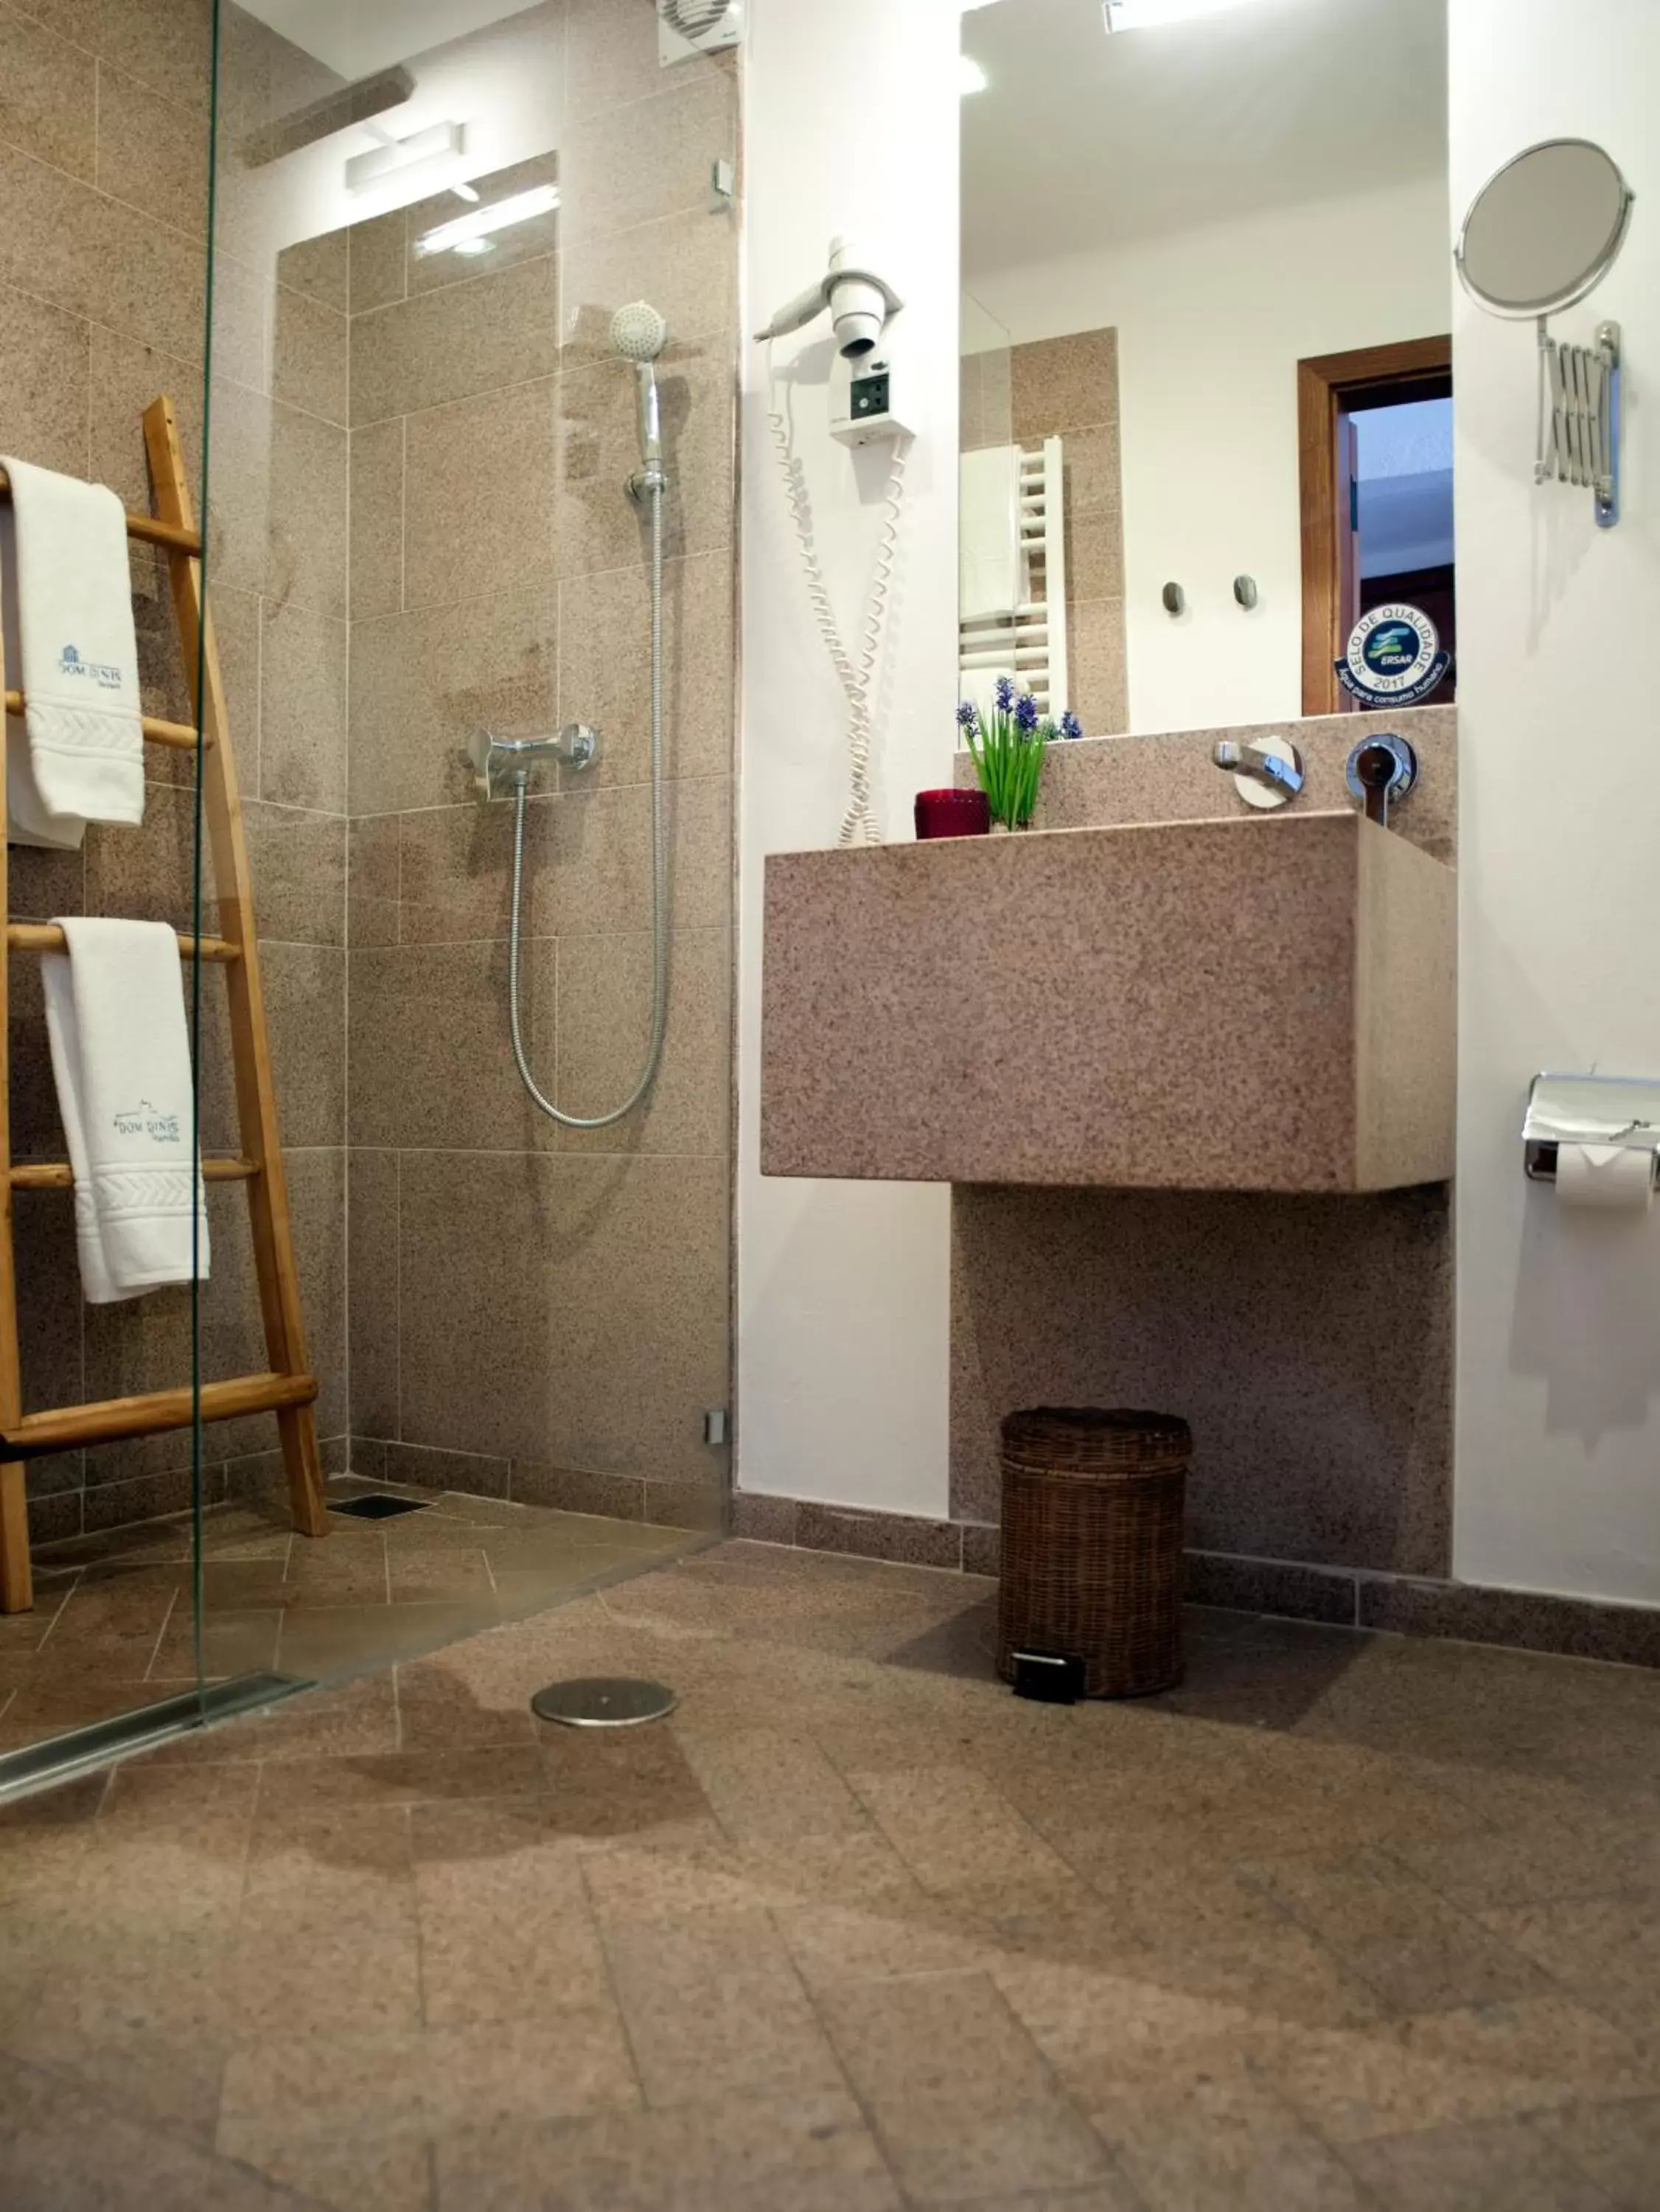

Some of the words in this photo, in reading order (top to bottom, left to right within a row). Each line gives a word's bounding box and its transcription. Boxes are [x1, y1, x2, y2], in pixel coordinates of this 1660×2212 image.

[1350, 636, 1365, 675] SELO
[1359, 613, 1378, 633] DE
[1382, 608, 1434, 672] QUALIDADE
[1381, 654, 1413, 666] ERSAR
[1352, 686, 1373, 701] para
[1373, 691, 1415, 703] consumo
[1414, 663, 1443, 694] humano
[1373, 676, 1404, 689] 2017
